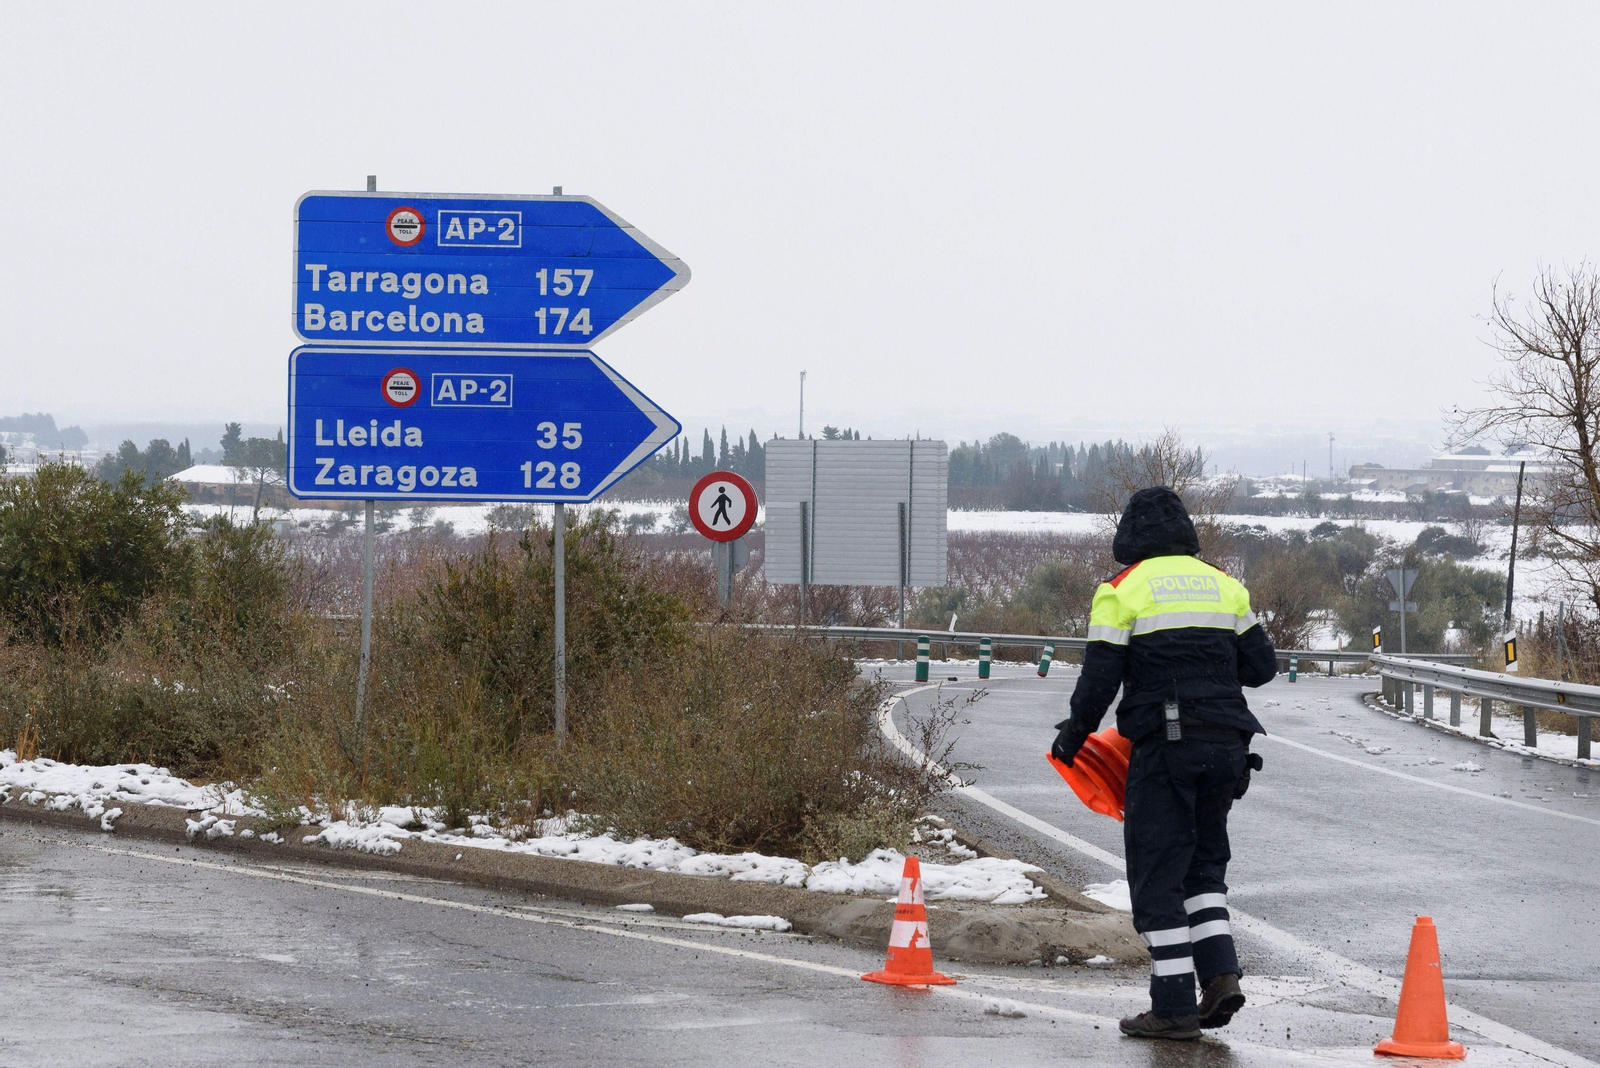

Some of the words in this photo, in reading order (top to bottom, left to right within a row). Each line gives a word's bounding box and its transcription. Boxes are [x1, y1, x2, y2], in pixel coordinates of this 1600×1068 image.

[445, 217, 515, 241] AP-2
[305, 264, 489, 299] Tarragona
[535, 269, 594, 297] 157
[304, 303, 485, 334] Barcelona
[534, 307, 593, 335] 174
[437, 379, 507, 402] AP-2
[315, 419, 423, 447] Lleida
[536, 421, 583, 450] 35
[314, 457, 478, 492] Zaragoza
[520, 461, 581, 490] 128
[1151, 577, 1217, 592] POLICIA
